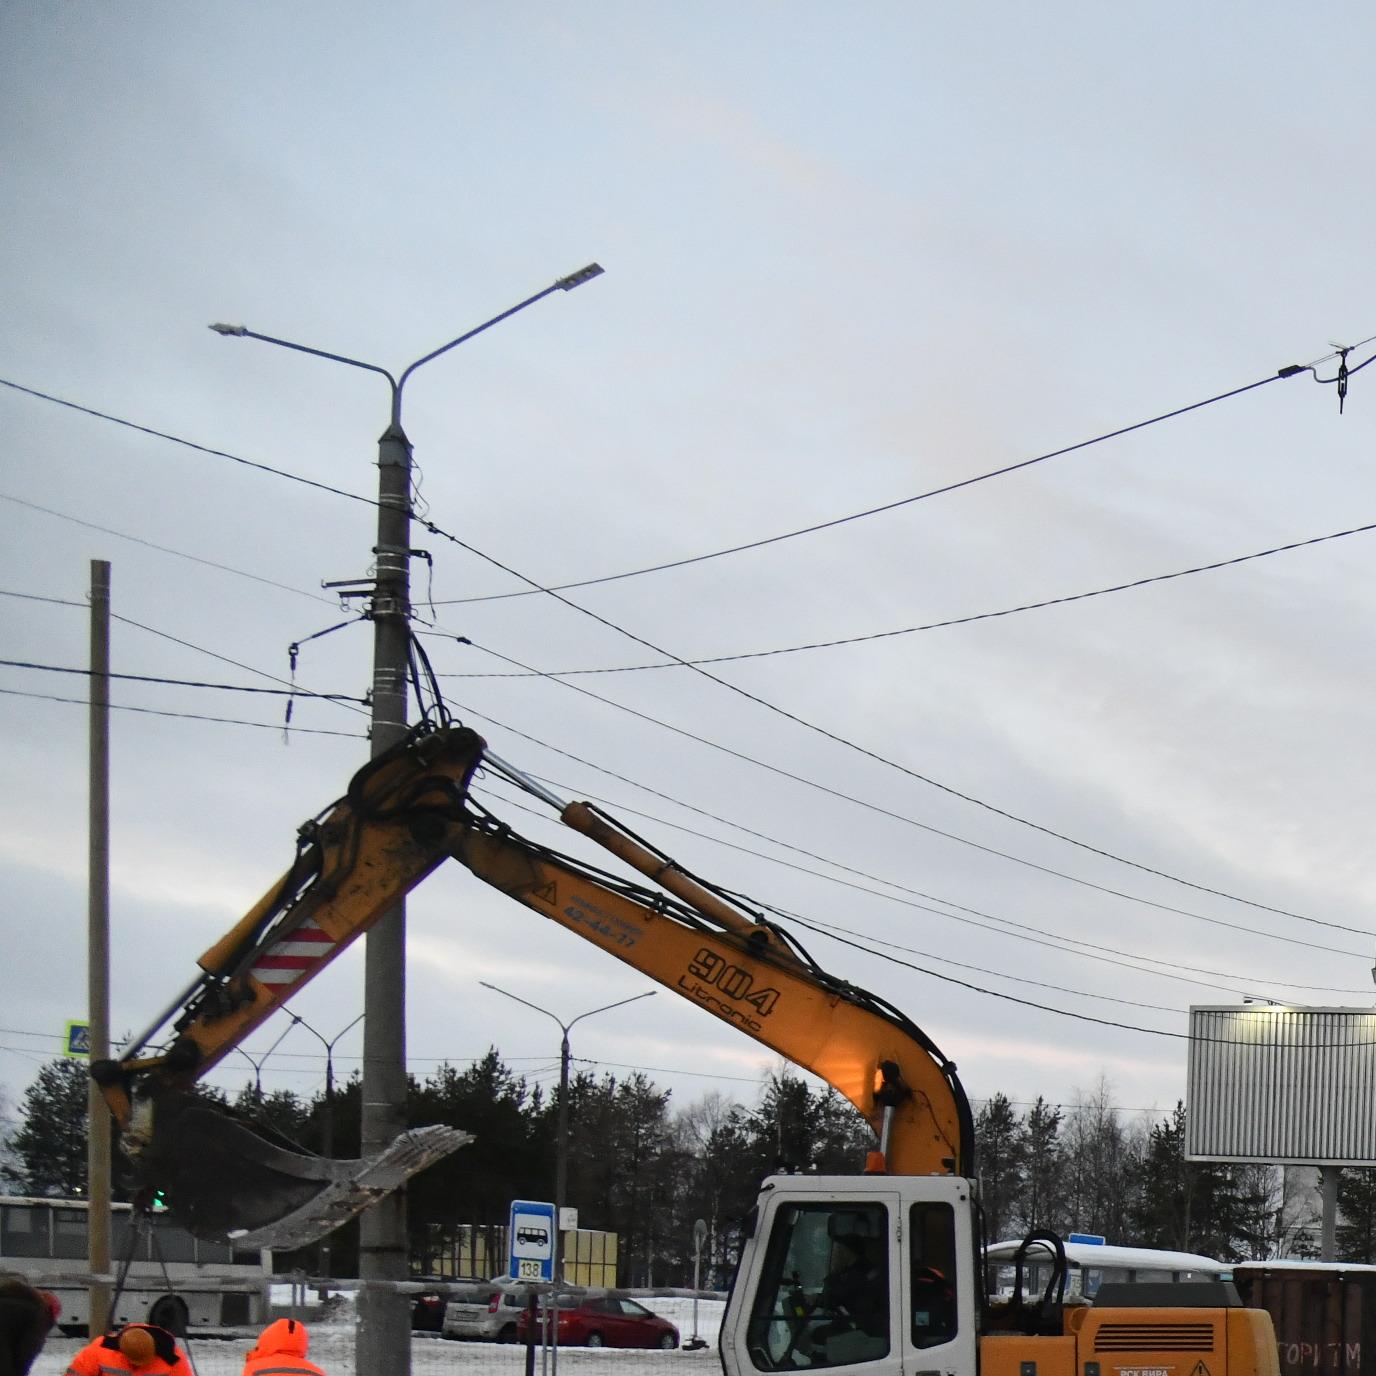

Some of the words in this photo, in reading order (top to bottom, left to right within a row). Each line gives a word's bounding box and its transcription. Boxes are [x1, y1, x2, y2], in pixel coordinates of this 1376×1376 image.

[678, 974, 763, 1032] Litronic
[688, 947, 781, 1017] 904
[520, 1262, 539, 1277] 138
